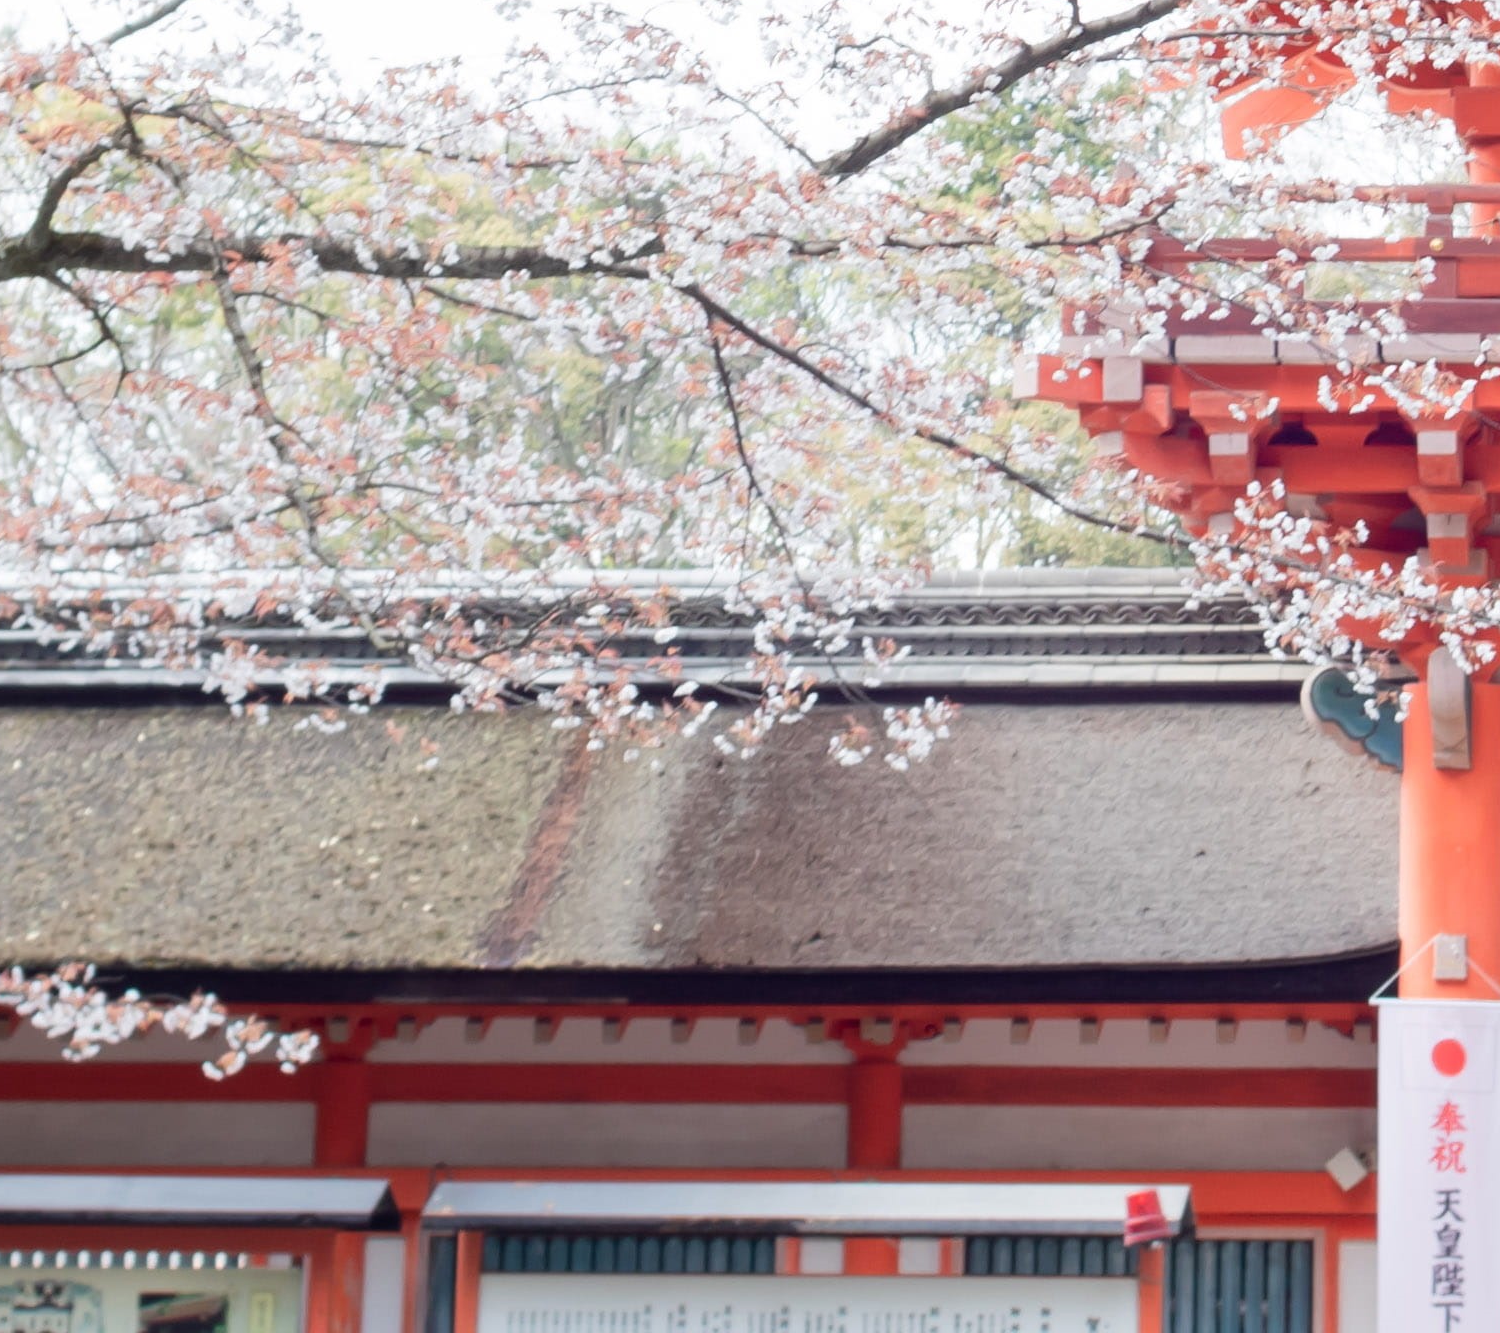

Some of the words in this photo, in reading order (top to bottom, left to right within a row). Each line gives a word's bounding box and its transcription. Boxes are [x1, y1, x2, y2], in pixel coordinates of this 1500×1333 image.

[1429, 1101, 1467, 1174] 奉祝
[1432, 1188, 1465, 1333] 天皇陛下
